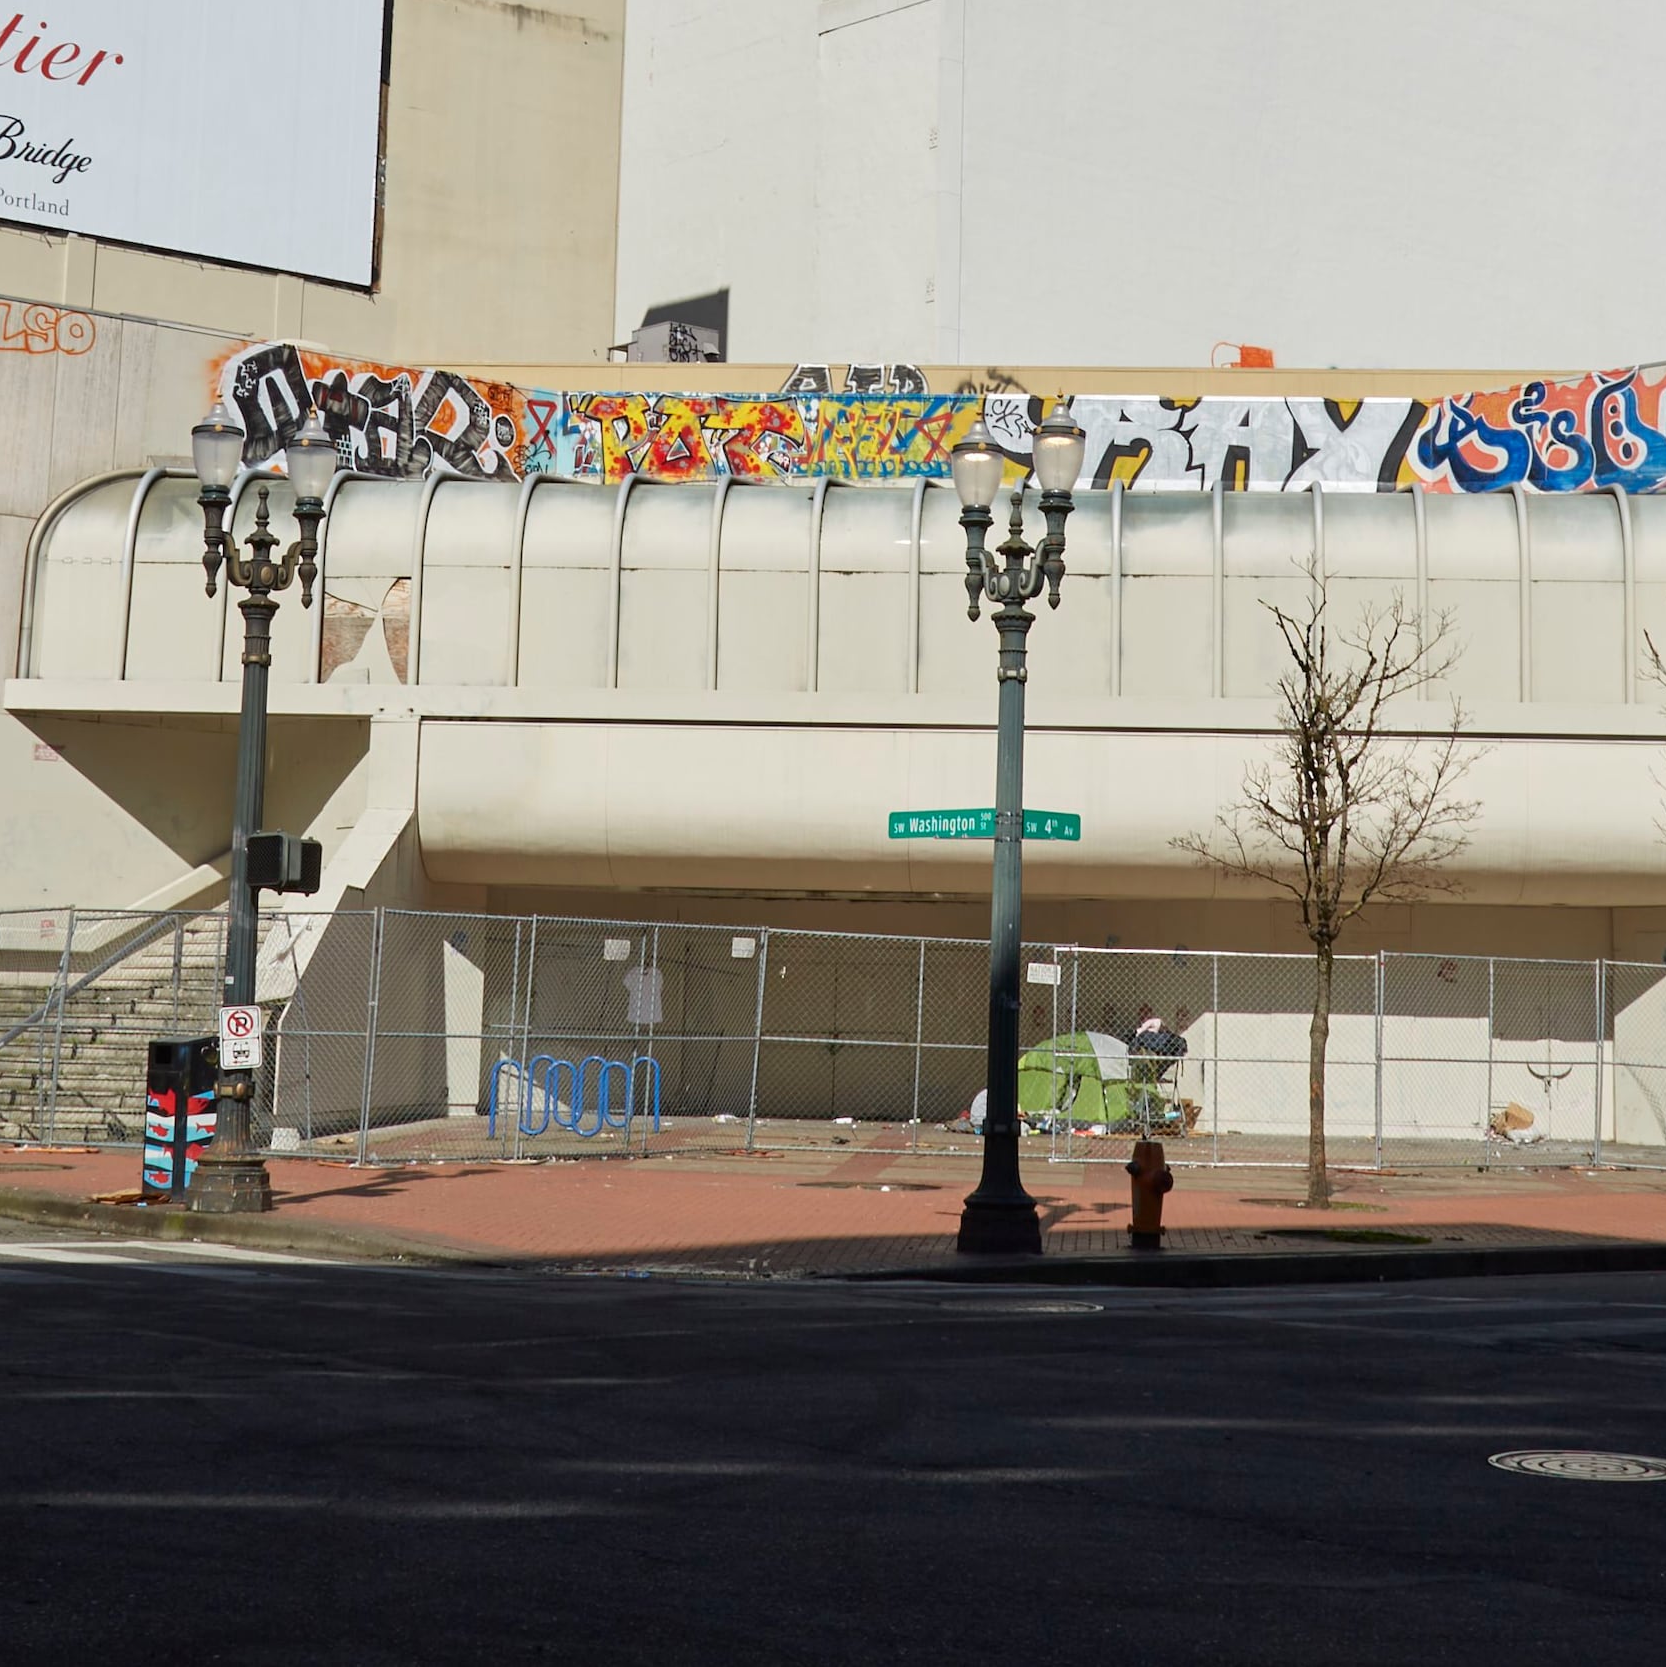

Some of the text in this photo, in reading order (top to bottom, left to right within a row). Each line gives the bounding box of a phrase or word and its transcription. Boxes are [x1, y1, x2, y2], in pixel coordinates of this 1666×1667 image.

[893, 822, 905, 833] SW
[909, 815, 976, 836] Washington
[1026, 819, 1074, 837] SW 4th Av
